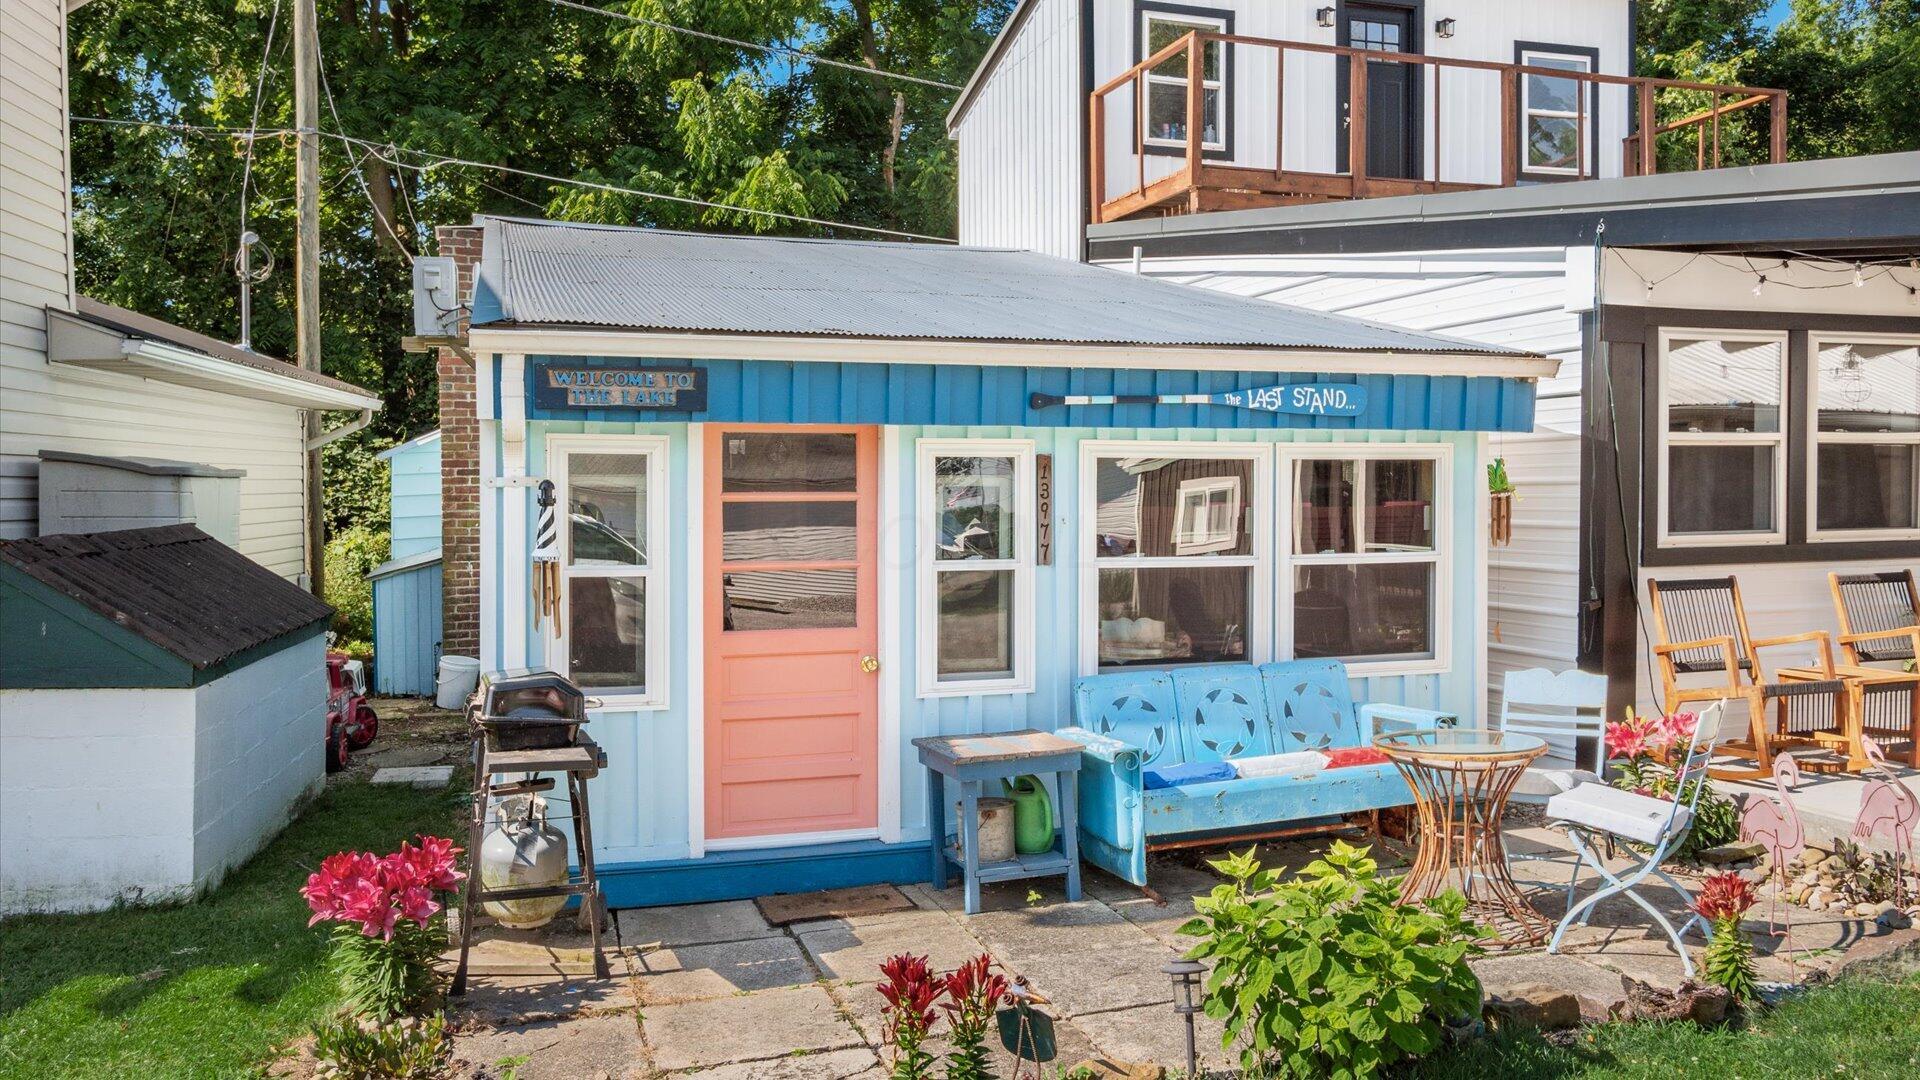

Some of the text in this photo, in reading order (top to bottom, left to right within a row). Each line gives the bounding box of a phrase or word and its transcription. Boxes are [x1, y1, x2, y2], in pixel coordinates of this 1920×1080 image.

[553, 371, 692, 387] WELCOME TO
[572, 389, 674, 405] THE LAKE
[1247, 387, 1285, 411] LAST
[1040, 464, 1050, 561] 13977
